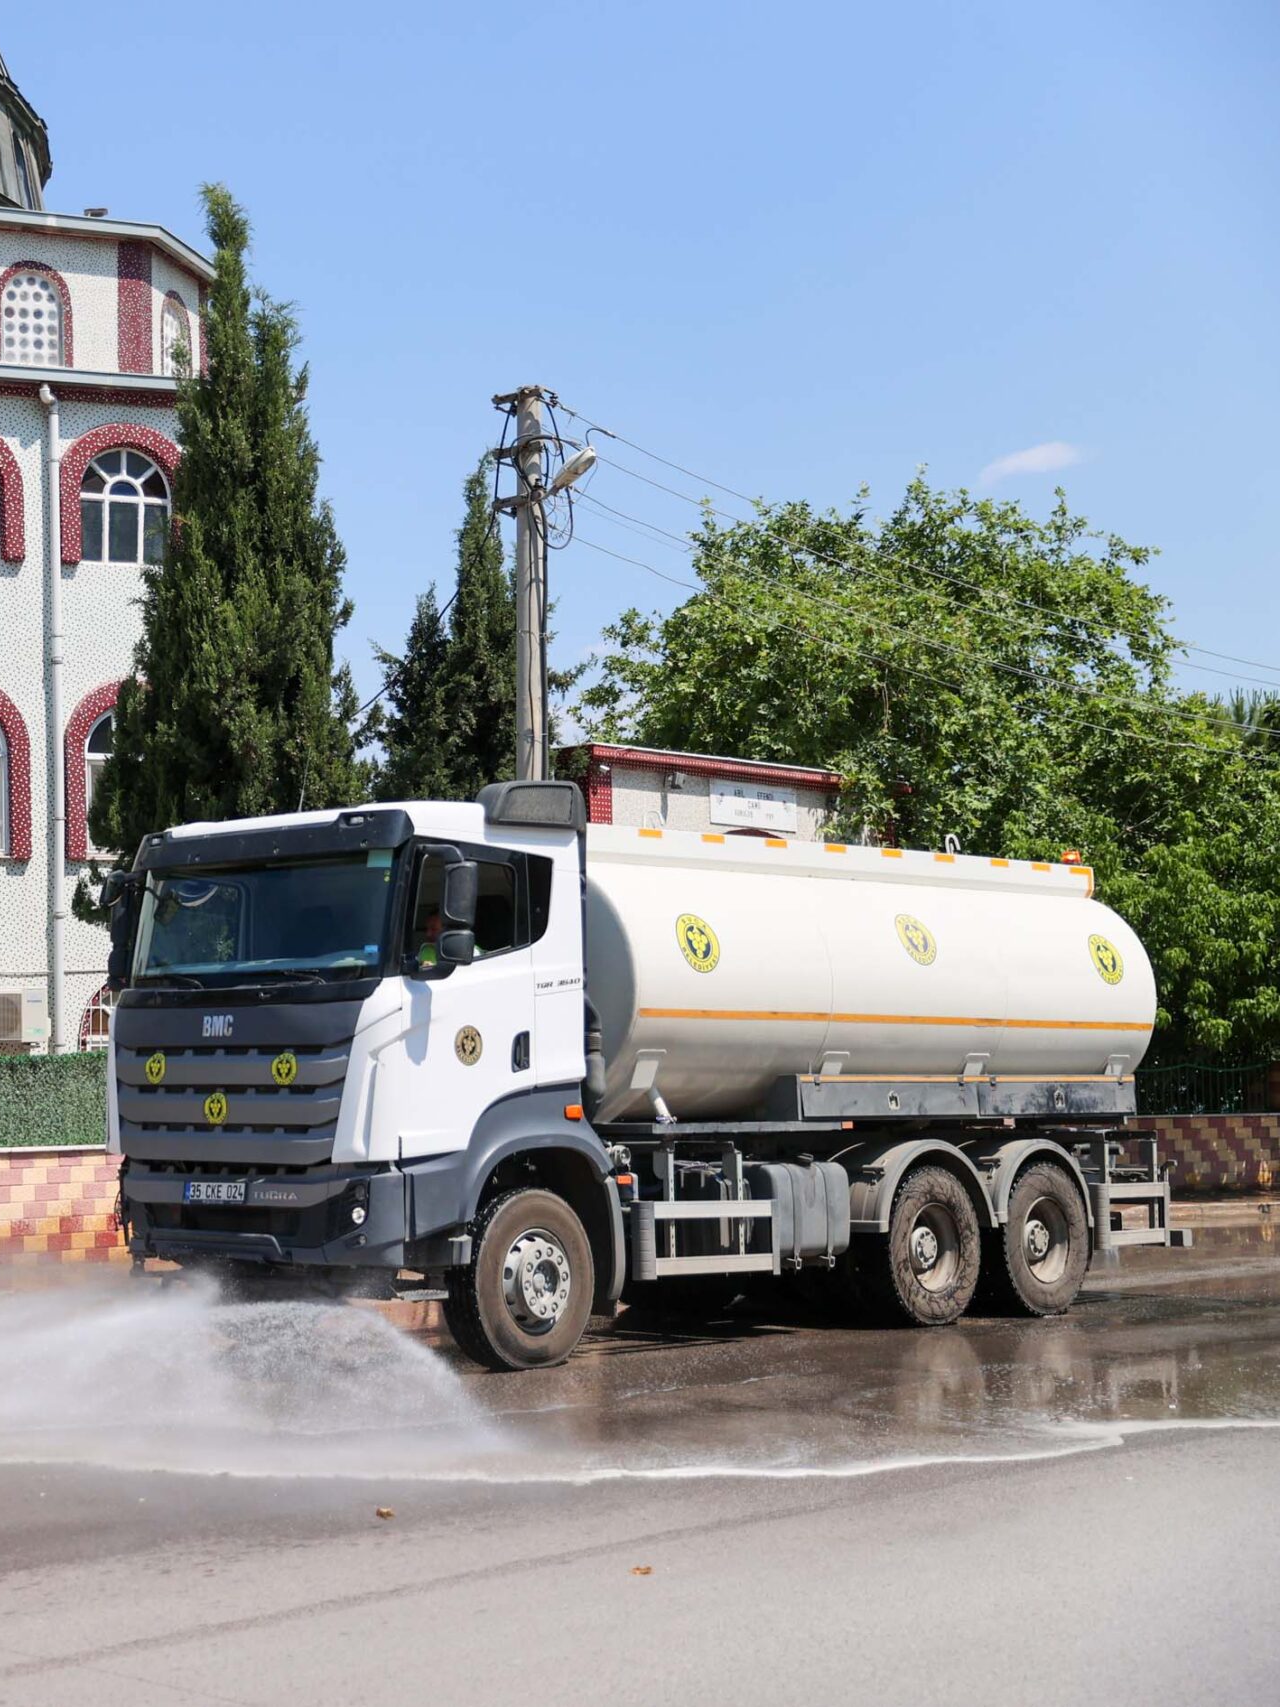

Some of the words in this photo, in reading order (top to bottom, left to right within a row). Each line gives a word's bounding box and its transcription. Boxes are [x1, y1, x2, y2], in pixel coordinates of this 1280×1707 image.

[202, 1015, 234, 1037] BMC
[190, 1185, 201, 1199] 35
[205, 1185, 222, 1199] CKE
[226, 1185, 243, 1199] 024
